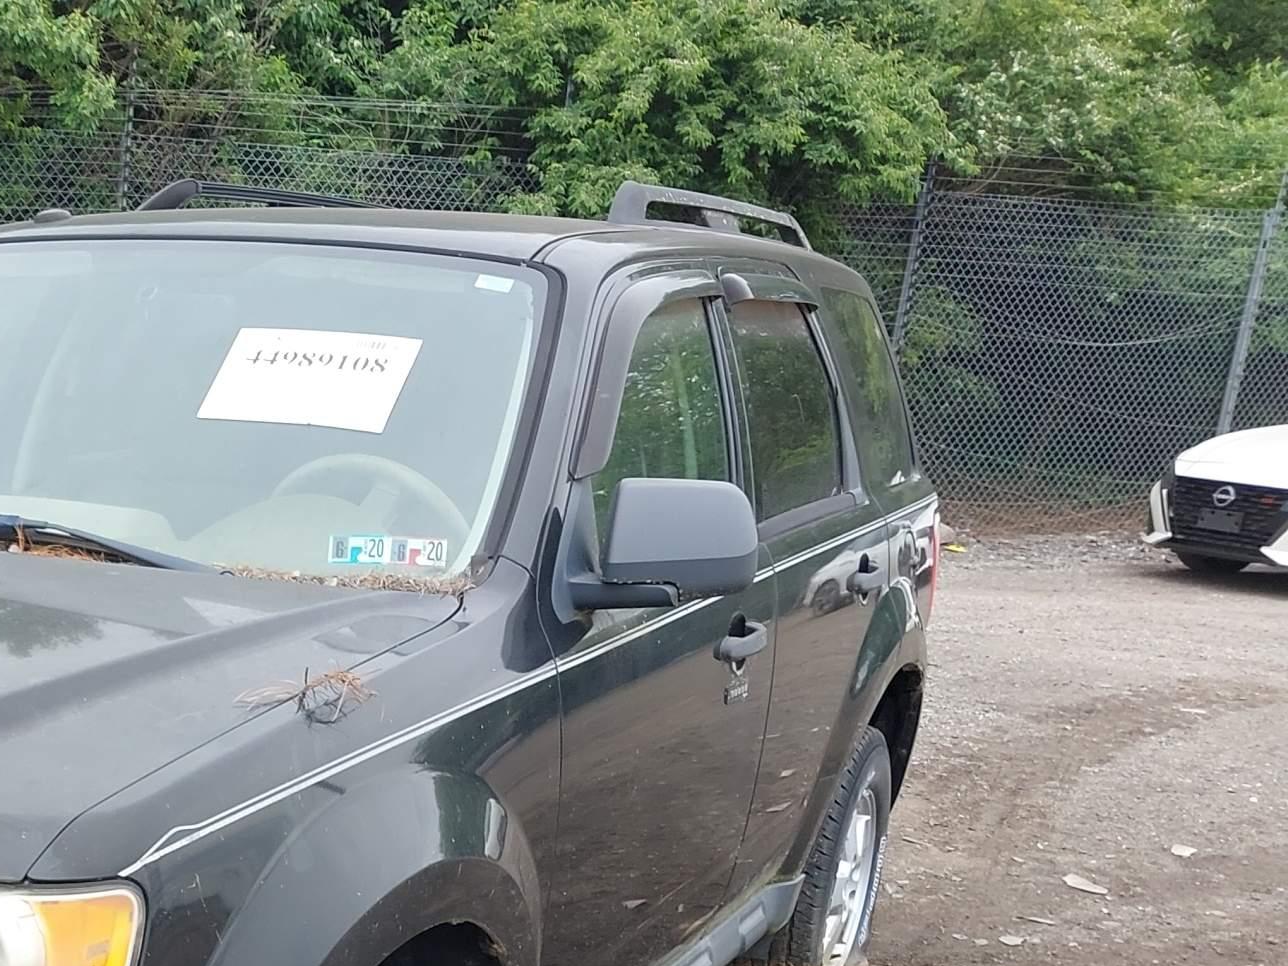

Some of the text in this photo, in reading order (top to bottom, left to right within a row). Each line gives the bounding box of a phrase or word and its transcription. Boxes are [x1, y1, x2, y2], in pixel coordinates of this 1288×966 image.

[245, 347, 390, 374] 44989108
[368, 538, 384, 558] 20
[427, 541, 443, 562] 20
